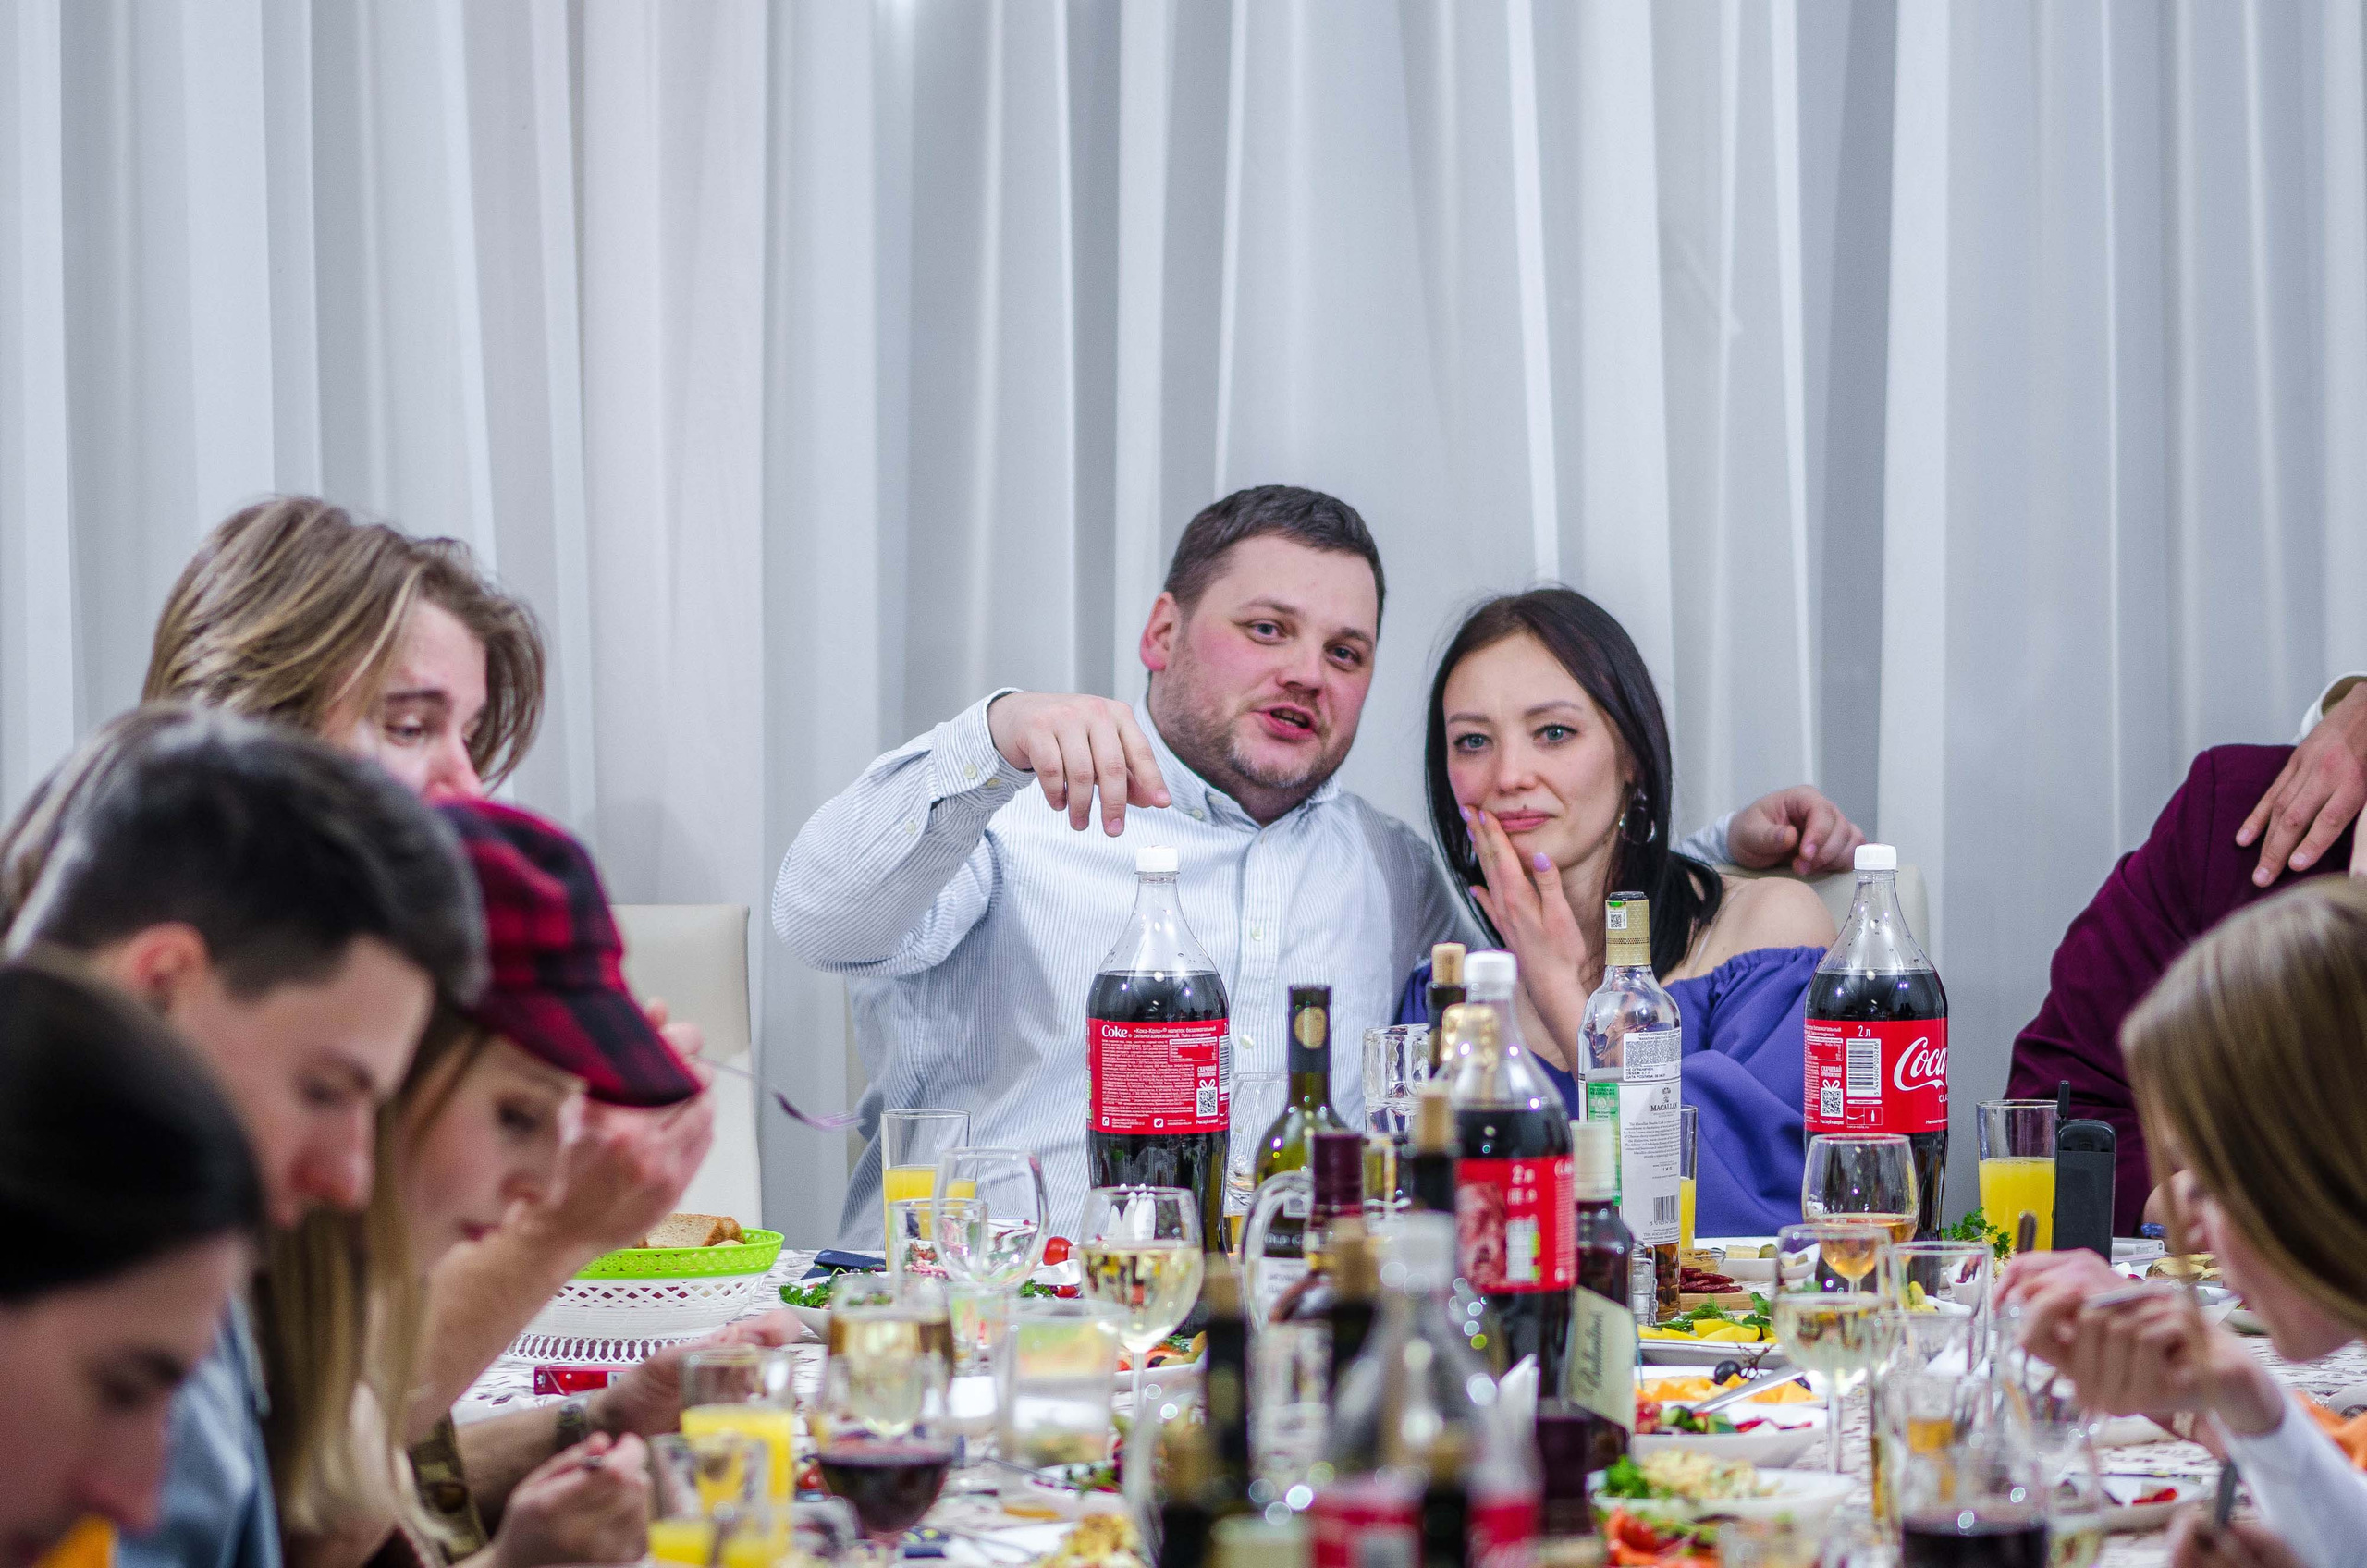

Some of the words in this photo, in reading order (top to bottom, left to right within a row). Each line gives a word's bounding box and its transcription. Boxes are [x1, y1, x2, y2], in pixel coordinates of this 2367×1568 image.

[1101, 1024, 1128, 1038] Coke
[1858, 1025, 1864, 1037] 2
[1894, 1036, 1947, 1091] Coca
[1650, 1102, 1678, 1112] MACALLAN
